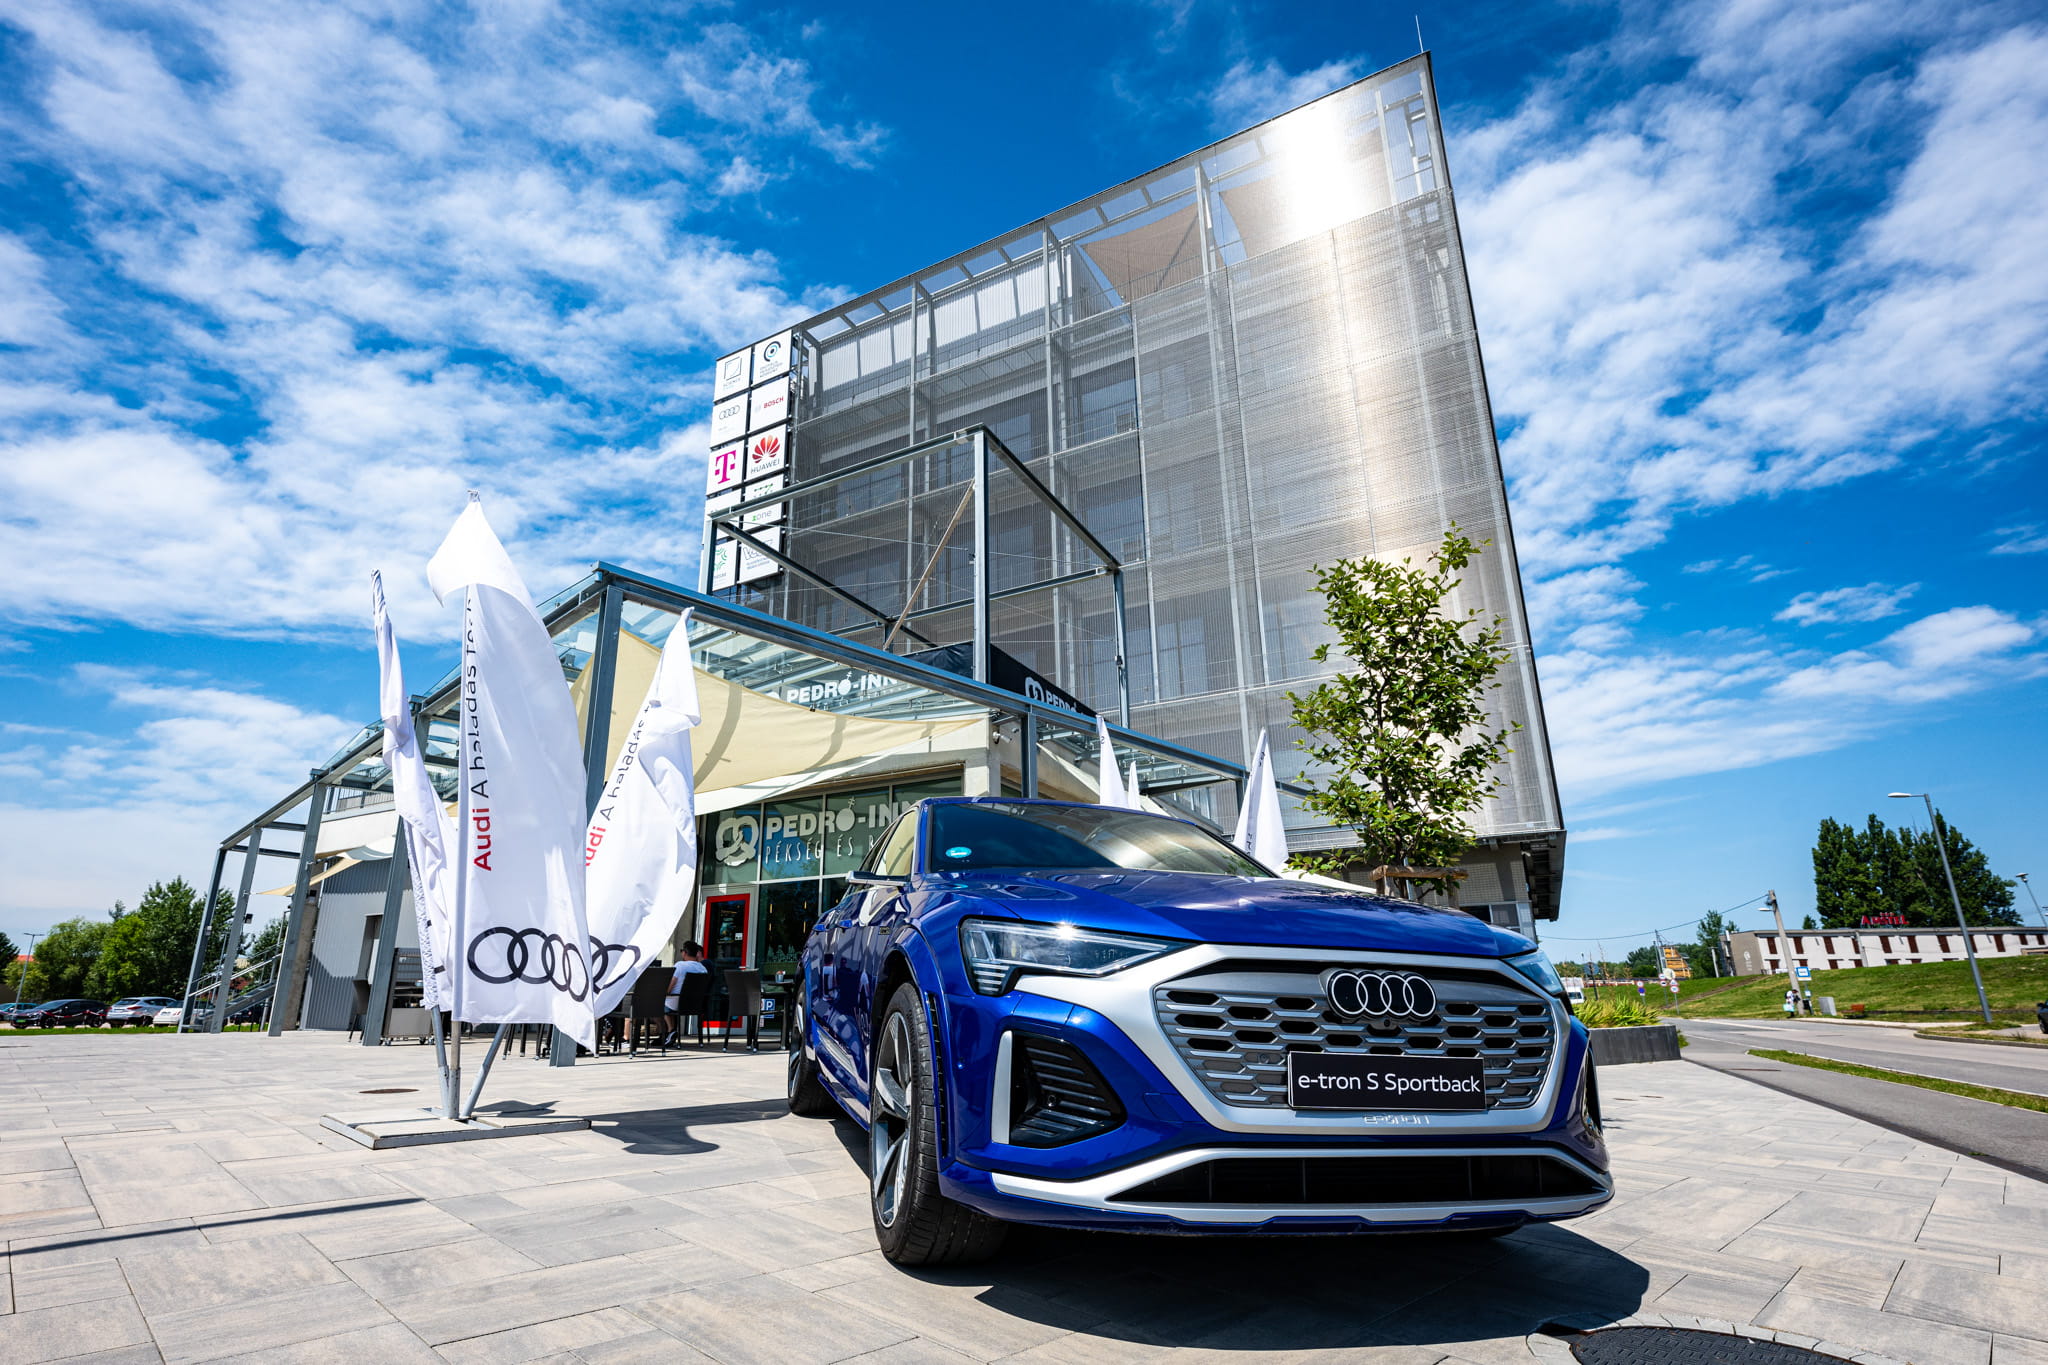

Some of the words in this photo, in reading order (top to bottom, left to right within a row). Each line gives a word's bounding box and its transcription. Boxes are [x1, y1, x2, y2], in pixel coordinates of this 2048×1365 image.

[763, 396, 784, 409] BOSCH
[751, 458, 780, 474] HUAWEI
[470, 779, 489, 799] A
[599, 806, 615, 821] A
[472, 807, 492, 871] Audi
[765, 837, 822, 865] PÉKSÉG
[837, 833, 853, 857] ÉS
[1298, 1072, 1361, 1090] e-tron
[1366, 1072, 1379, 1090] S
[1384, 1073, 1481, 1095] Sportback
